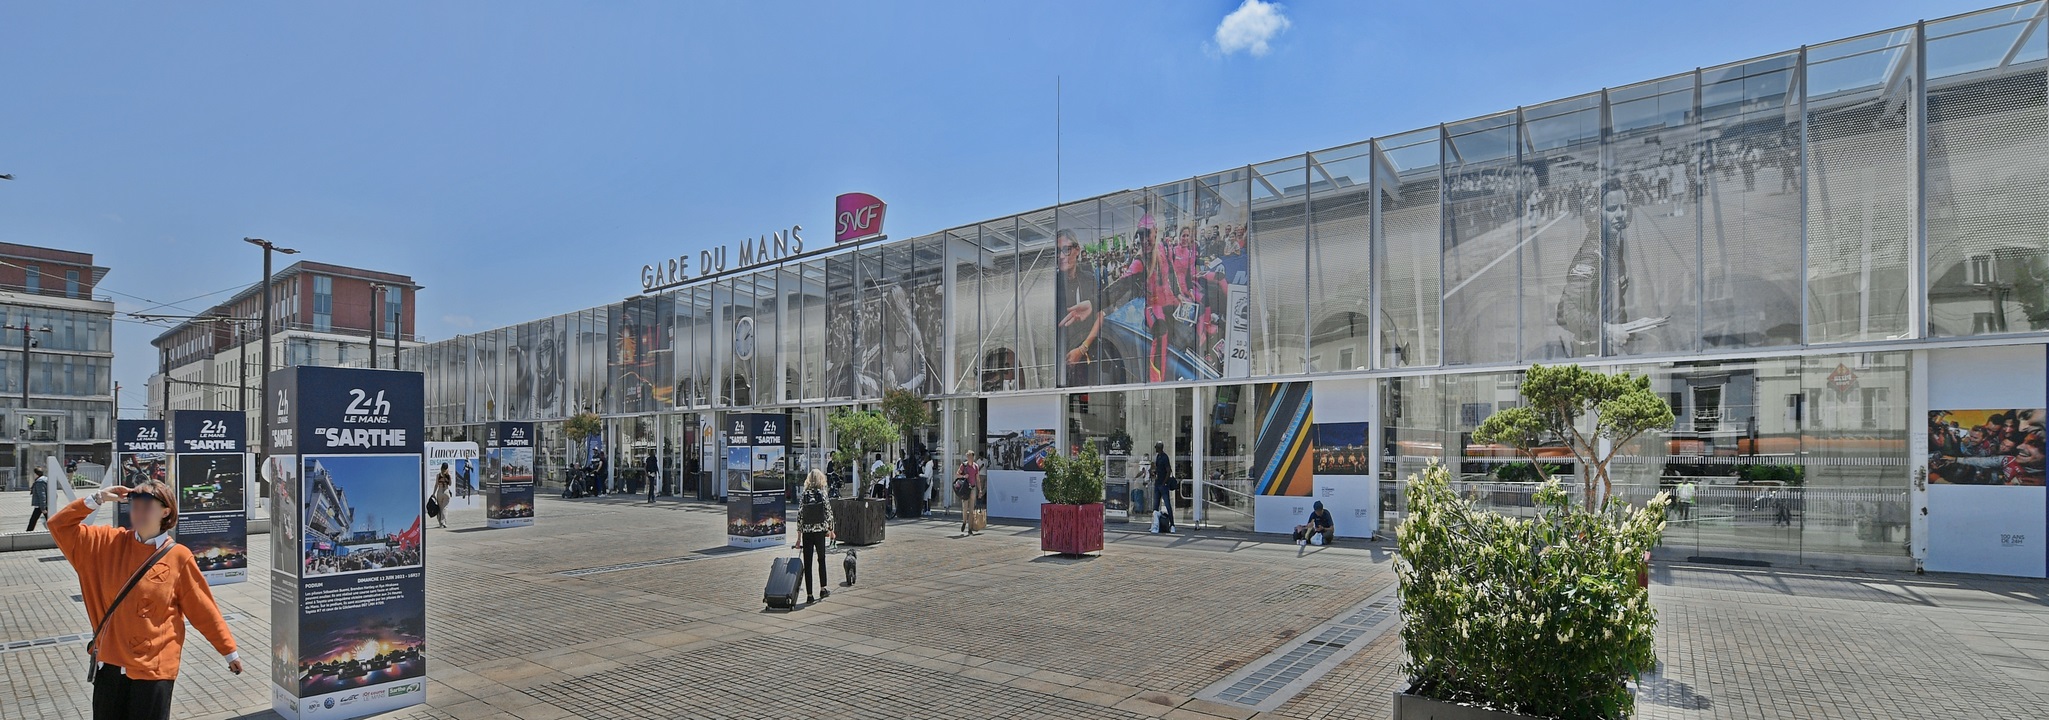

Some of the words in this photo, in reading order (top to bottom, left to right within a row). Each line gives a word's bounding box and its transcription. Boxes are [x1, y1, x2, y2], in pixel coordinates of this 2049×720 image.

[836, 204, 880, 236] SNCF
[642, 255, 688, 288] GARE
[700, 245, 726, 276] DU
[739, 225, 804, 267] MANS
[346, 388, 390, 416] 24h
[137, 427, 158, 438] 24h
[200, 420, 227, 434] 24h
[190, 440, 236, 450] SARTHE
[326, 428, 406, 448] SARTHE
[758, 436, 780, 444] SARTHE
[129, 442, 165, 450] SARTHE
